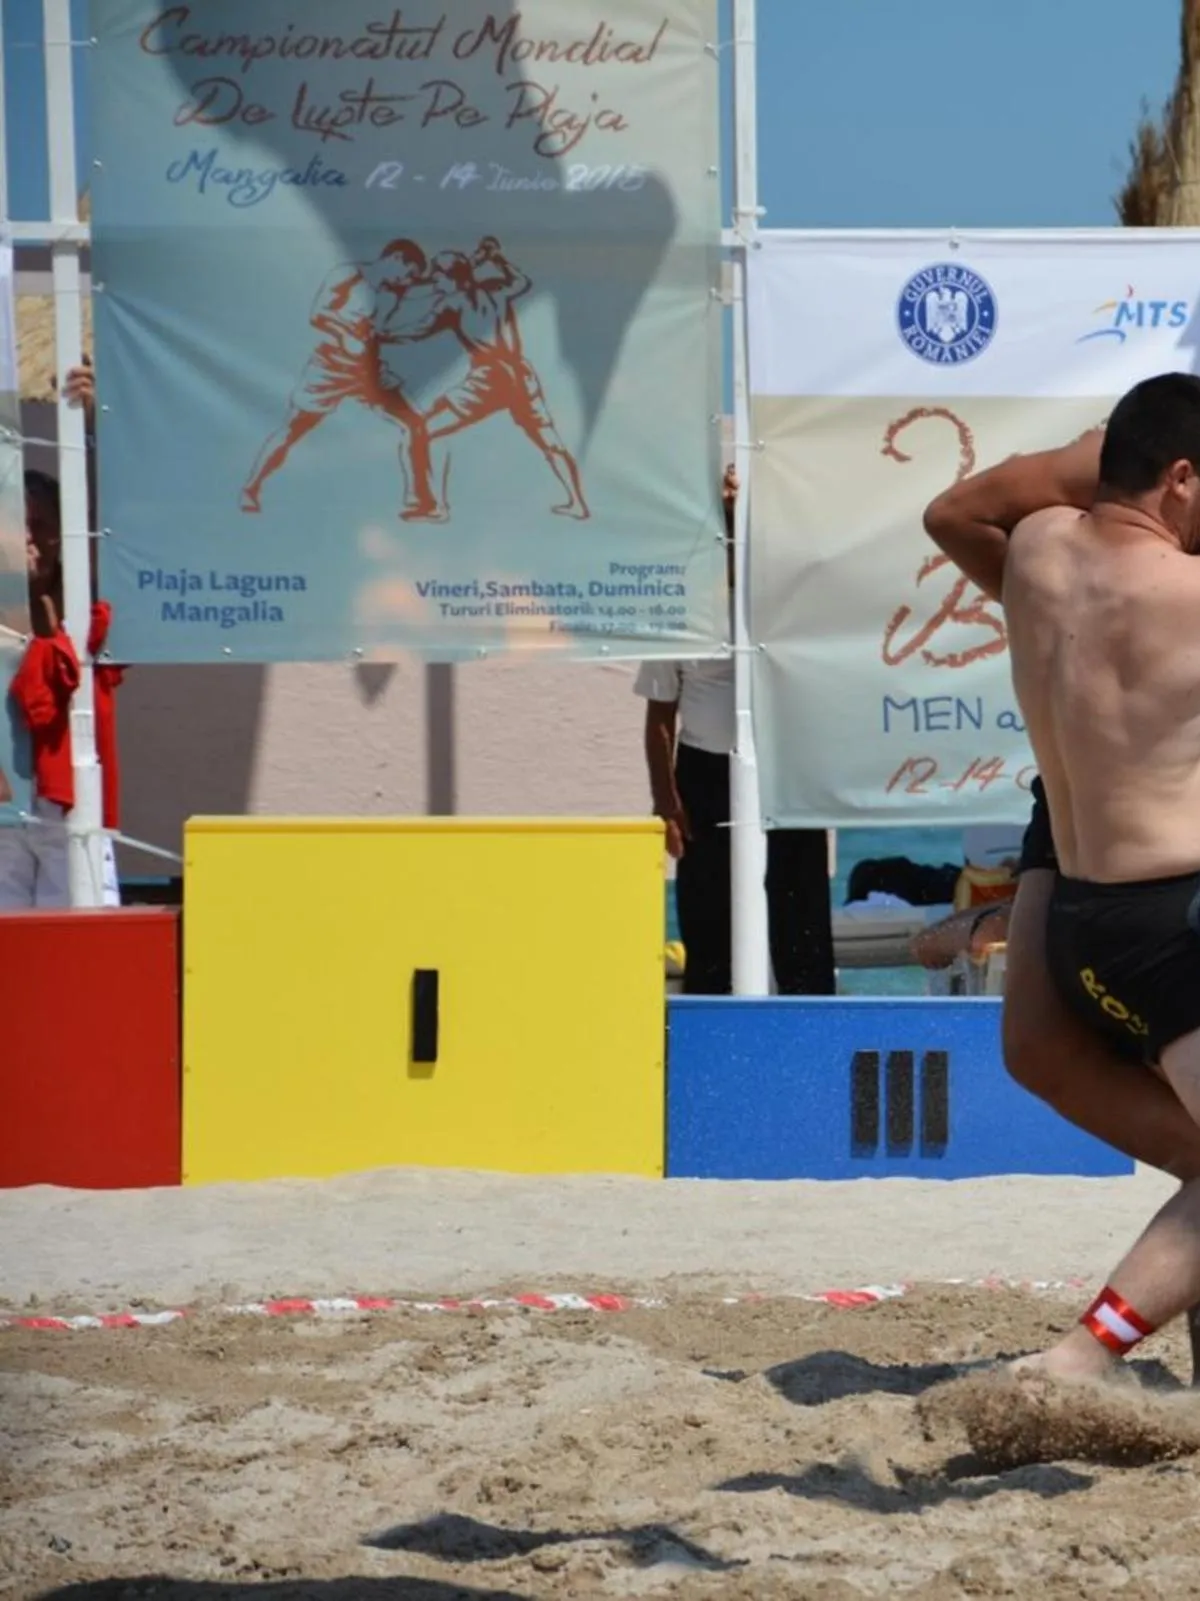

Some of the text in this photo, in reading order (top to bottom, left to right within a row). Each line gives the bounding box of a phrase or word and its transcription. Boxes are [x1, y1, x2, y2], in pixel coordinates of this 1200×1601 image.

[141, 6, 669, 76] Campionatul Mondial
[174, 76, 277, 127] De
[419, 79, 488, 128] Pe
[505, 84, 629, 158] Plaja
[166, 148, 348, 208] Mangalia
[365, 161, 404, 189] 12
[439, 161, 481, 190] 14
[1114, 300, 1187, 328] MTS
[138, 568, 308, 598] Plaja Laguna
[588, 580, 686, 598] Duminica
[161, 601, 284, 629] Mangalia
[883, 695, 983, 733] MEN
